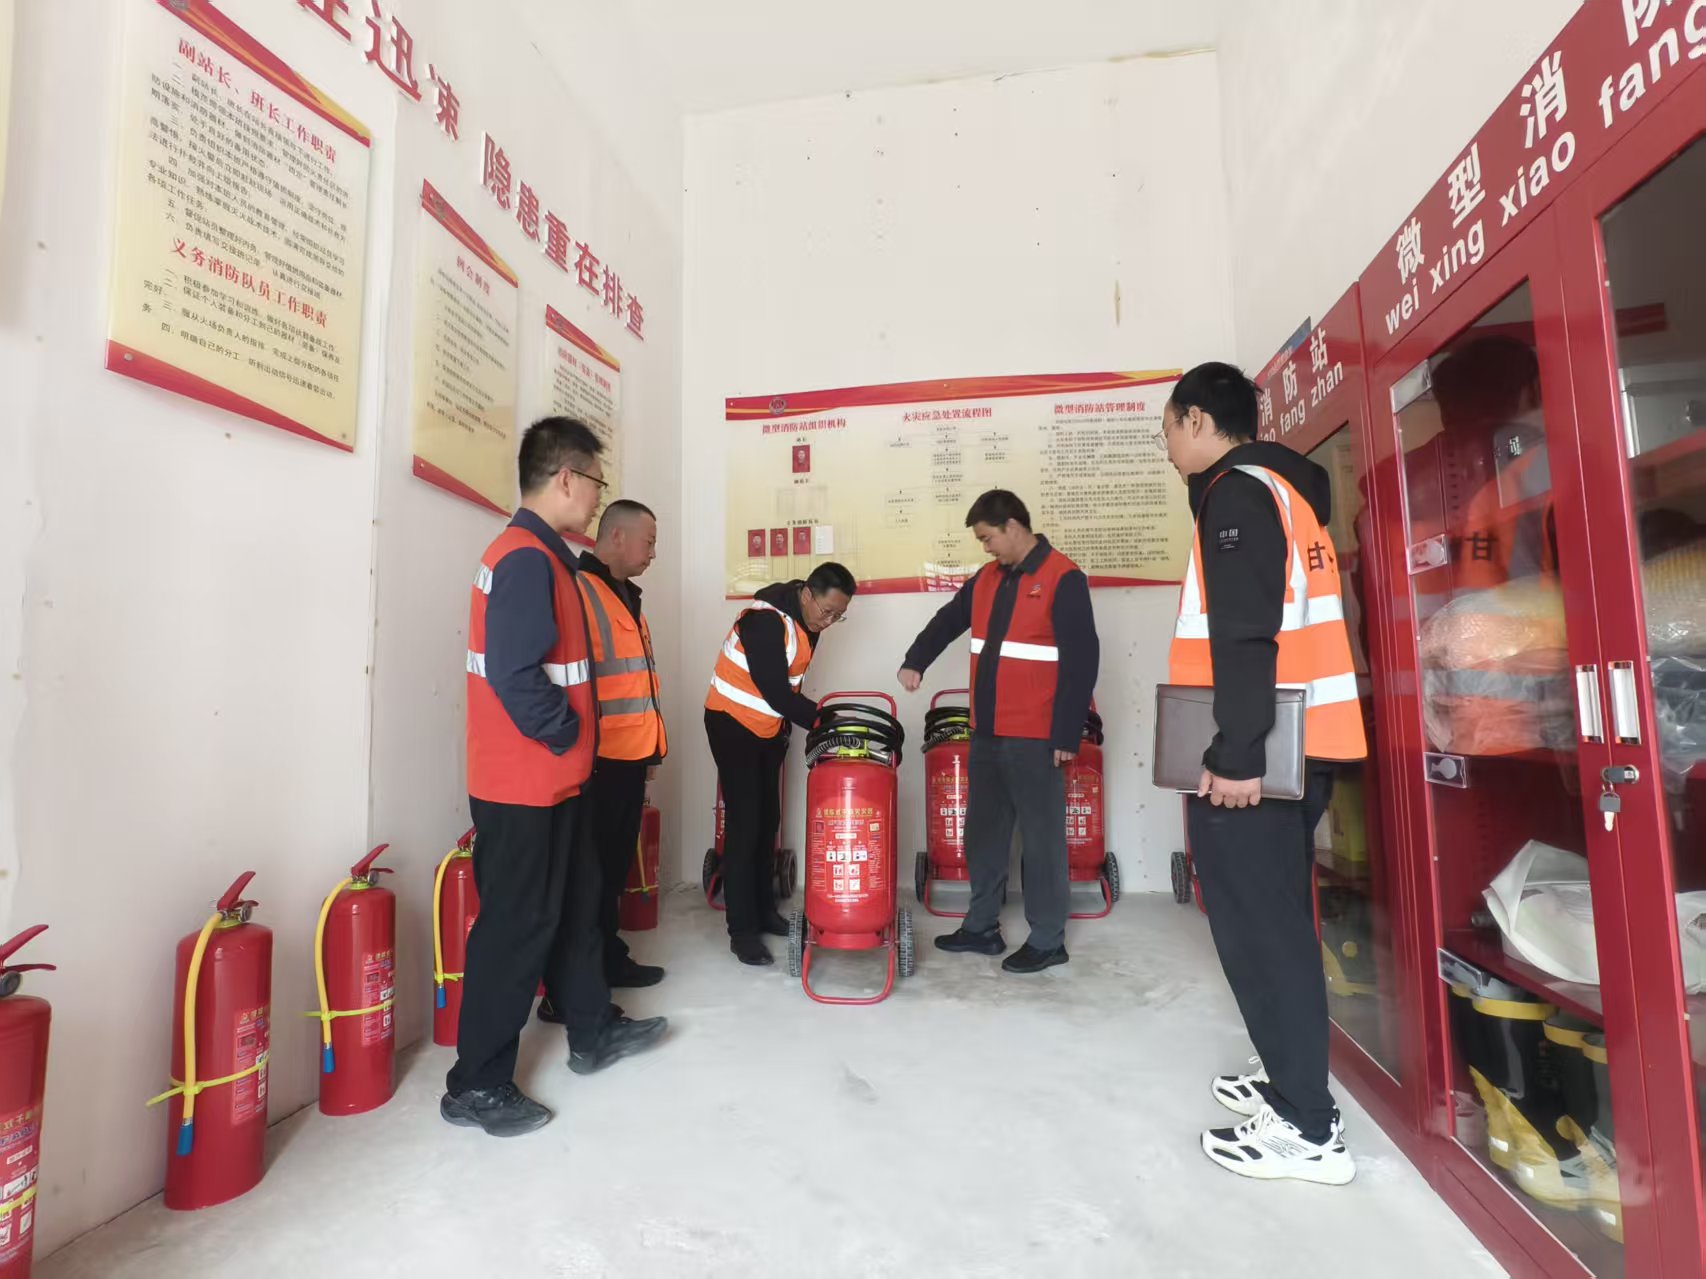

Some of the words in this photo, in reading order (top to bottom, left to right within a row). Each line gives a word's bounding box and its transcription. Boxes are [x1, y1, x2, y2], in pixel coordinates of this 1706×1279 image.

[178, 36, 337, 166] 副站长、班长工作职责
[1385, 279, 1420, 335] wei
[1428, 218, 1485, 295] xing
[1499, 131, 1576, 227] xiao
[1598, 0, 1706, 129] fang
[170, 235, 328, 330] 义务消防队员工作职责
[484, 131, 645, 341] 隐患重在排查
[902, 407, 993, 422] 火灾应急处置流程图
[1054, 401, 1146, 415] 微型消防站管理制度
[1280, 399, 1306, 436] fang
[1310, 361, 1344, 408] zhan
